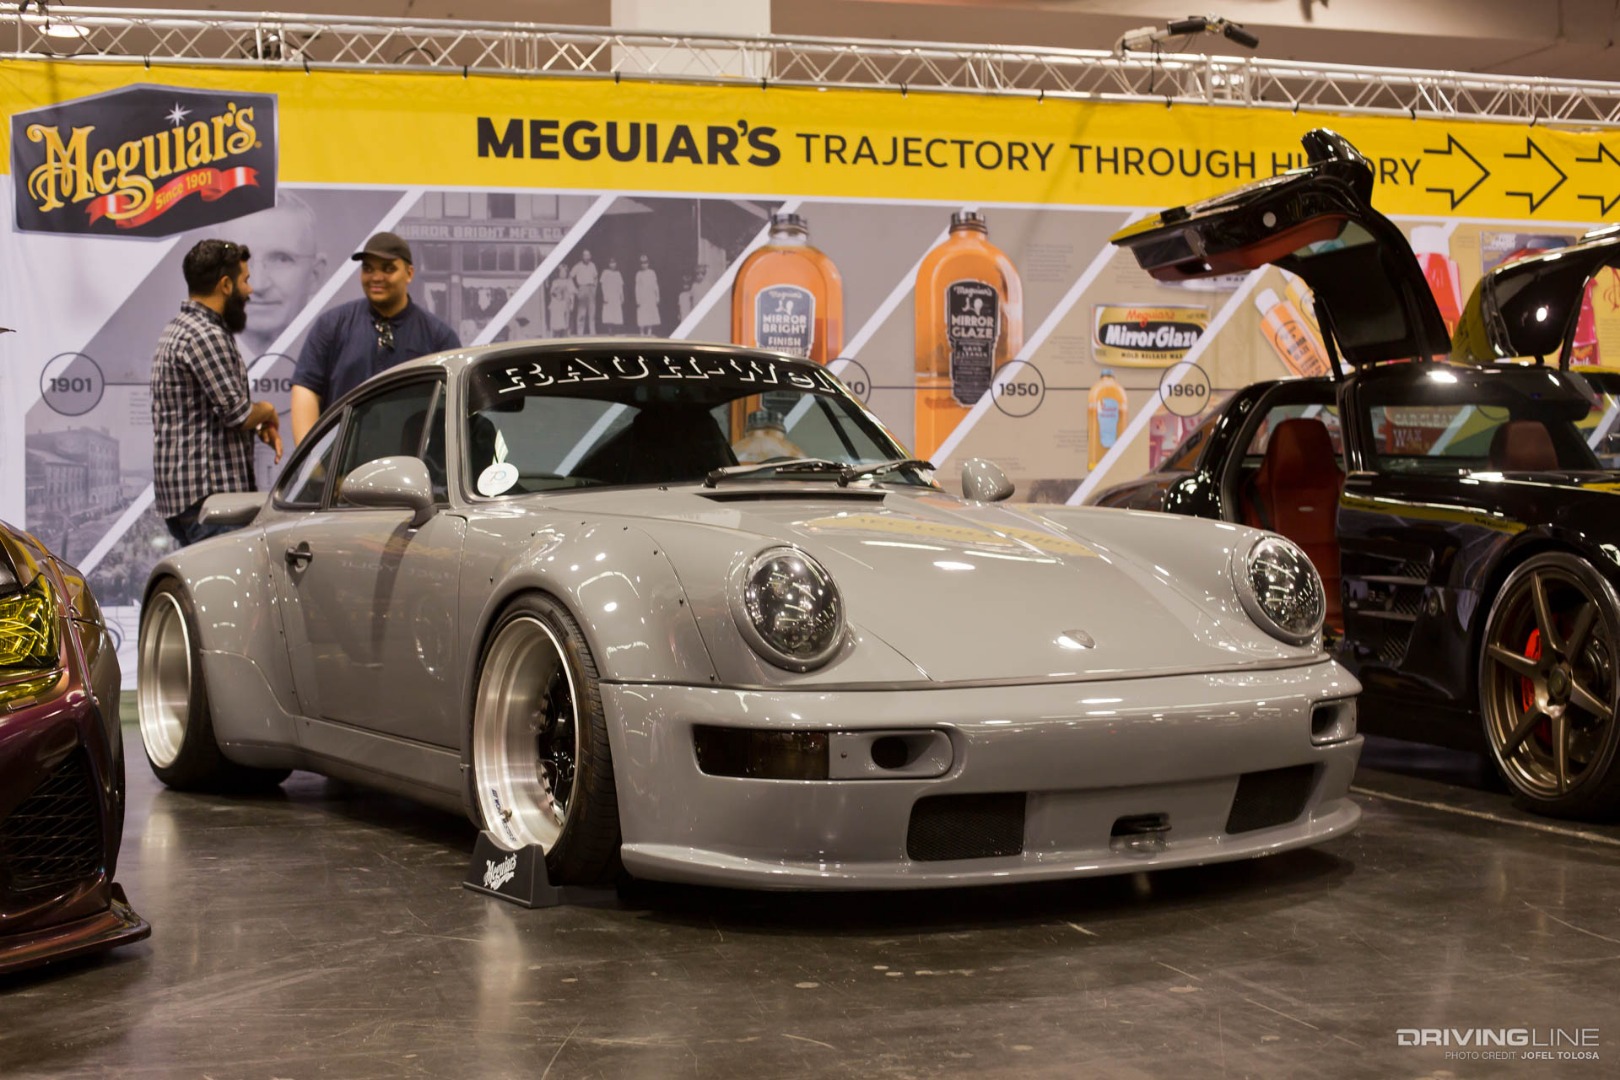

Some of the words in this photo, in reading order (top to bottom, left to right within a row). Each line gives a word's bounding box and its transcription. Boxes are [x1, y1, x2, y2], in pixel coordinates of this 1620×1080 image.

[477, 117, 781, 167] MEGUIAR'S
[796, 132, 1055, 172] TRAJECTORY
[1070, 144, 1256, 179] THROUGH
[26, 102, 256, 220] Meguiar's
[155, 182, 183, 211] Since
[185, 170, 212, 193] 1901
[453, 226, 505, 239] BRIGHT
[763, 314, 807, 325] MIRROR
[952, 314, 994, 328] MIRROR
[762, 323, 807, 335] BRIGHT
[952, 326, 994, 339] GLAZE
[768, 336, 801, 347] FINISH
[50, 377, 92, 393] 1901
[999, 382, 1039, 397] 1950
[1167, 384, 1206, 398] 1960
